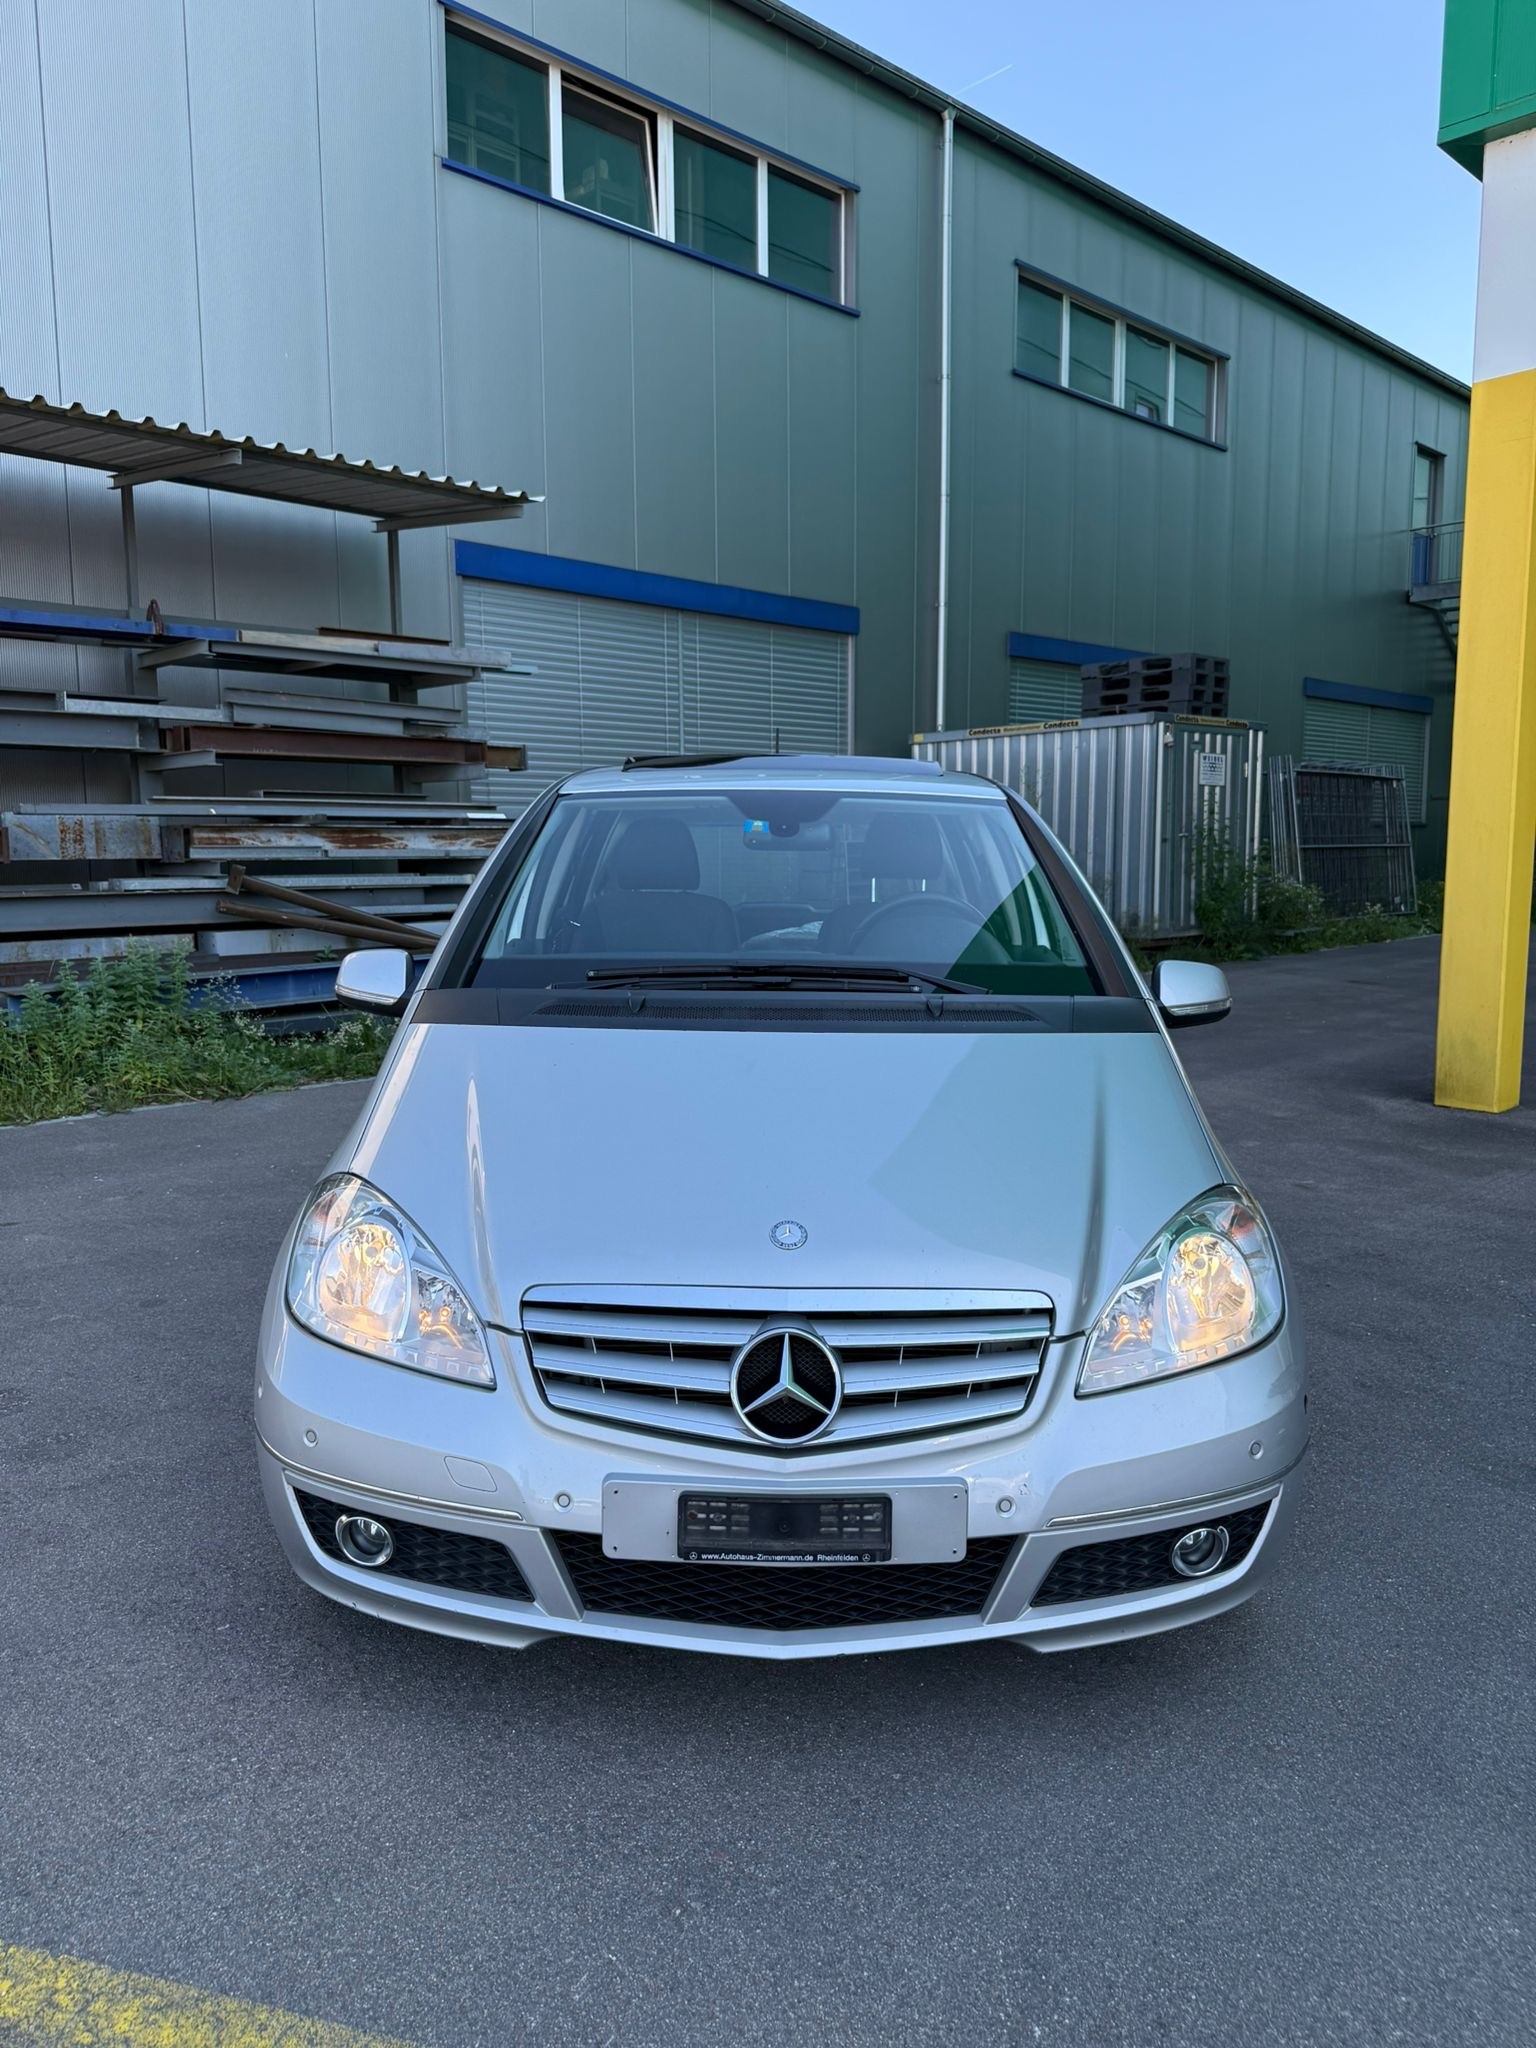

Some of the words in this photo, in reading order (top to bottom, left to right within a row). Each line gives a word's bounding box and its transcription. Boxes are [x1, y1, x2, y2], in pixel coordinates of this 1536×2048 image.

[968, 728, 1001, 737] Condecta
[1043, 720, 1079, 730] Condecta
[701, 1552, 814, 1562] www.Autohaus-Zimmermann.de
[817, 1553, 859, 1562] Rheinfelden
